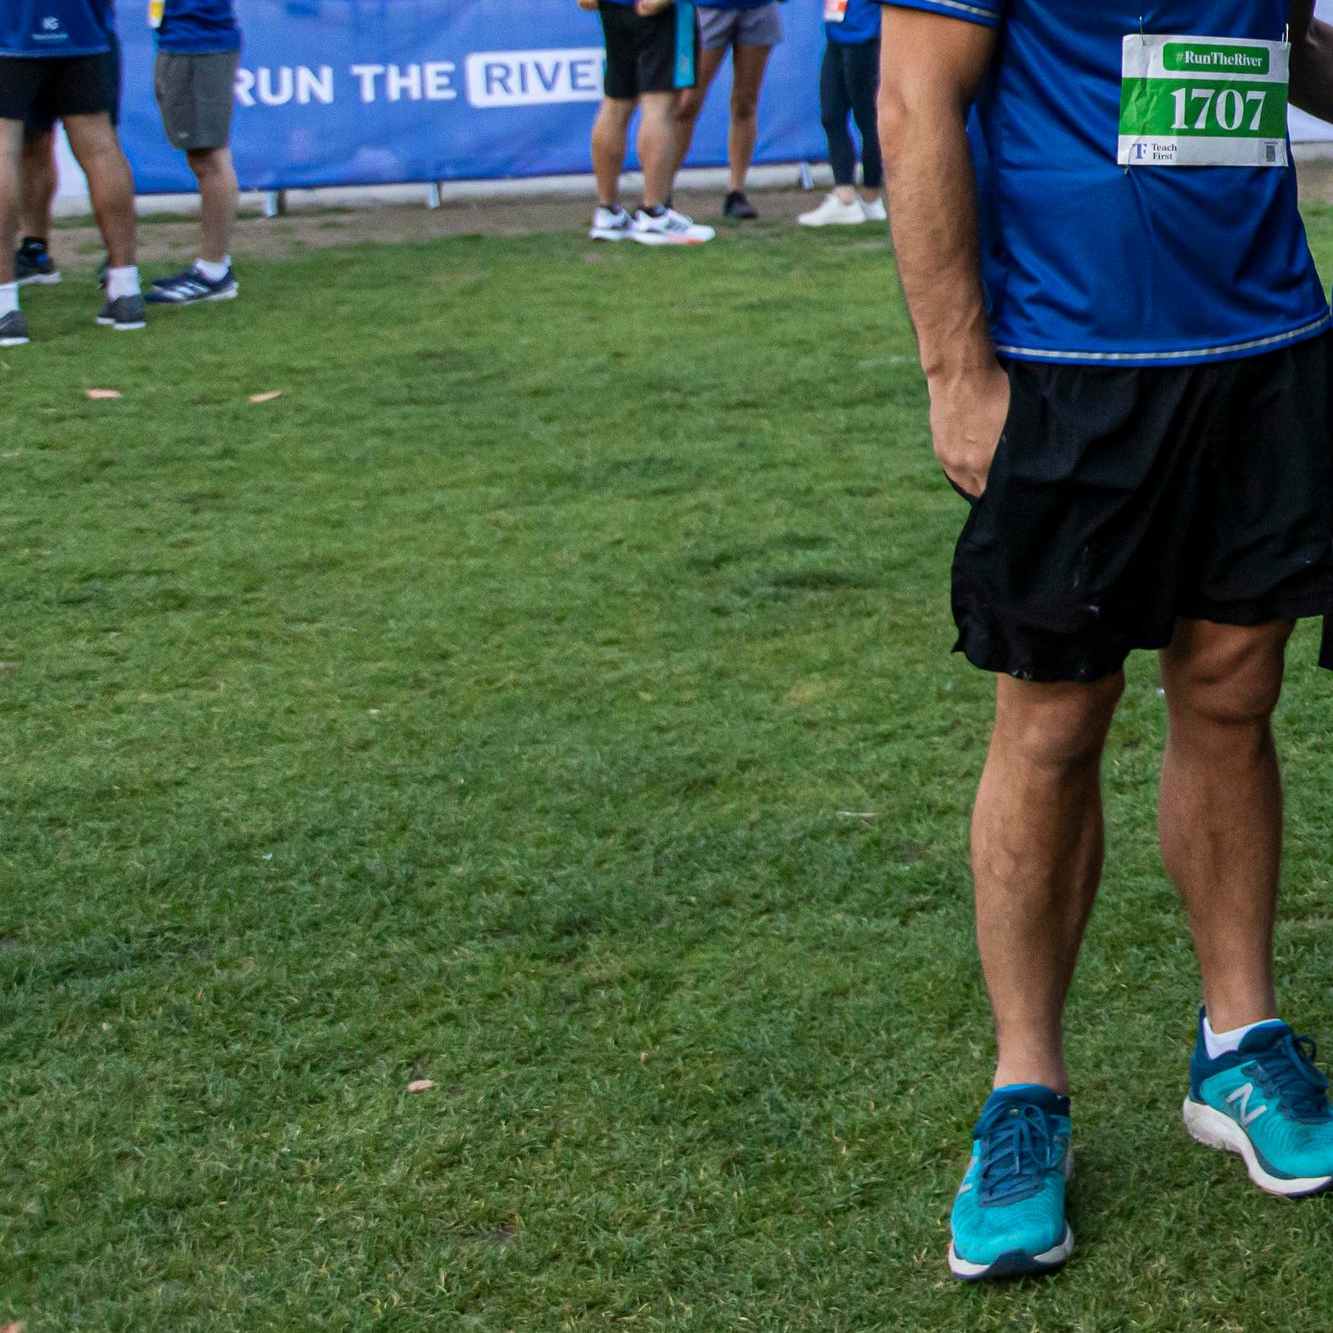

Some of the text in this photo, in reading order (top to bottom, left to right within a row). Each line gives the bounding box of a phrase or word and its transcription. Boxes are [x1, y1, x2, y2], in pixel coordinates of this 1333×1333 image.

[352, 62, 457, 103] THE
[484, 58, 605, 96] RIVE
[1171, 87, 1267, 131] 1707
[1151, 143, 1177, 152] Teach
[1152, 152, 1173, 160] First
